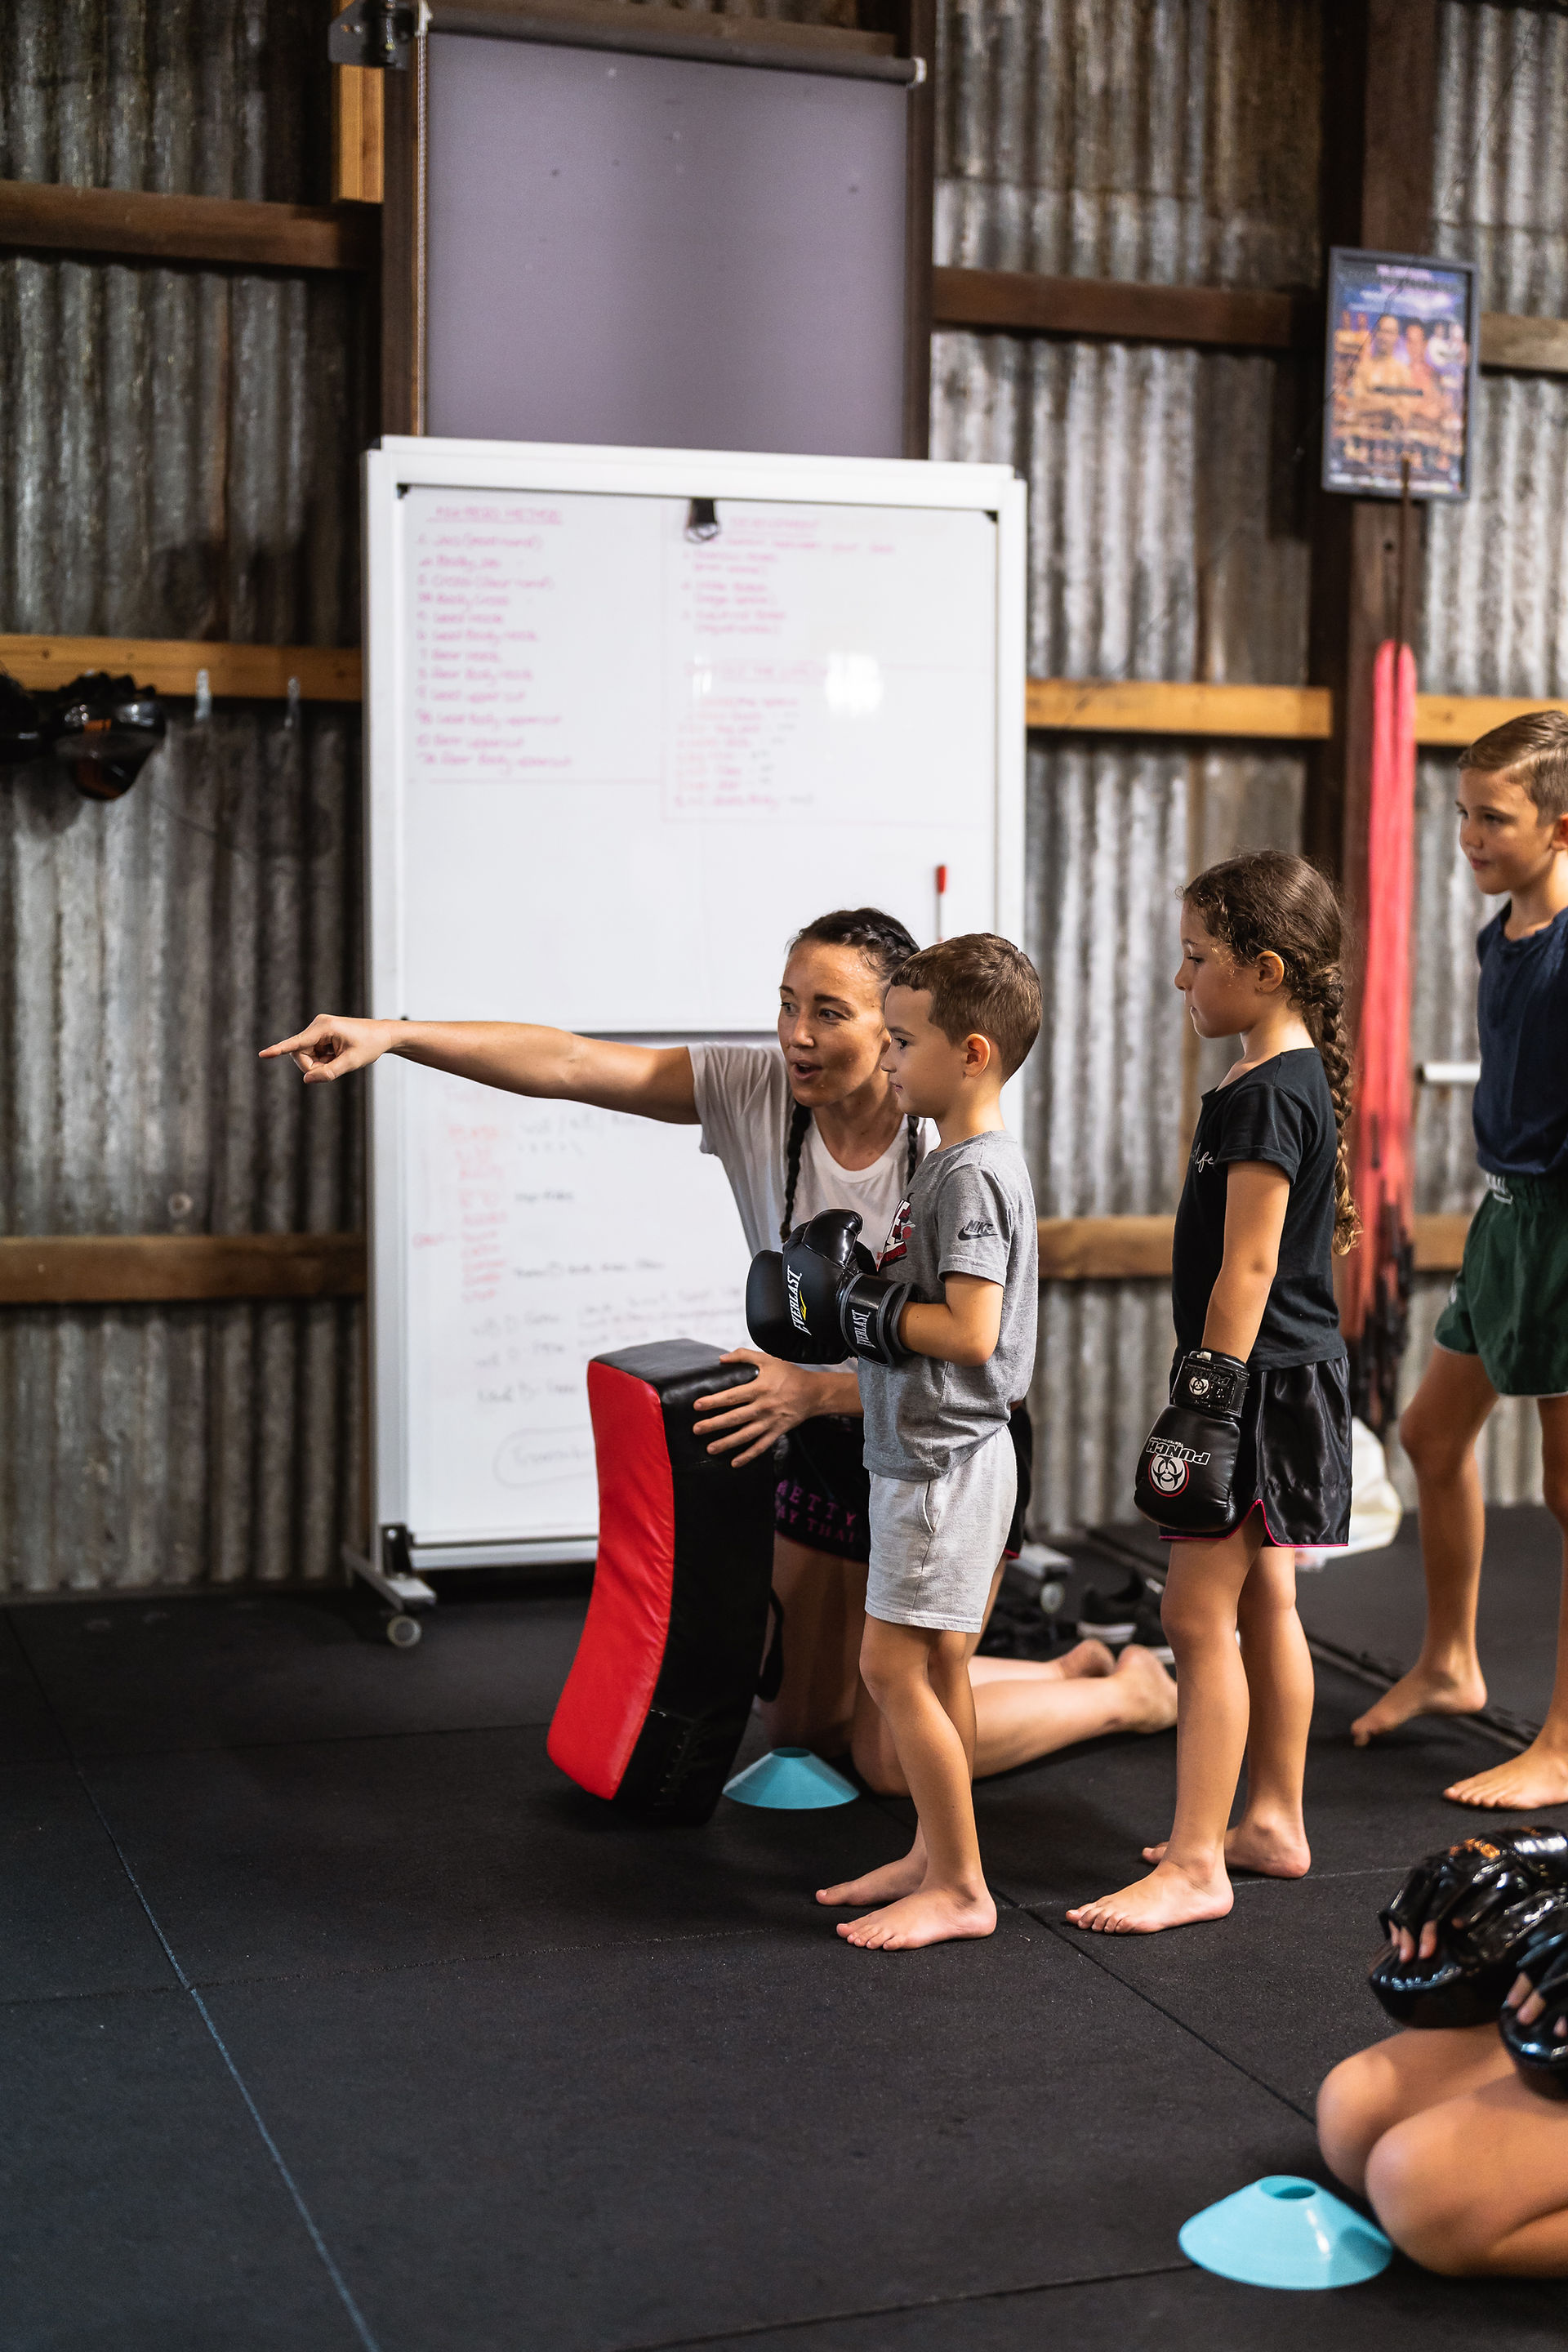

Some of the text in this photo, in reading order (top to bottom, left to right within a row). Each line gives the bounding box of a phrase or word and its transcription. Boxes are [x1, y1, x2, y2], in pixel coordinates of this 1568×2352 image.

[965, 1219, 995, 1234] NIKE
[786, 1265, 812, 1336] EVERLAST
[852, 1309, 876, 1348] EVERLAST
[1145, 1441, 1211, 1465] PUNCH
[805, 1516, 856, 1543] THAI
